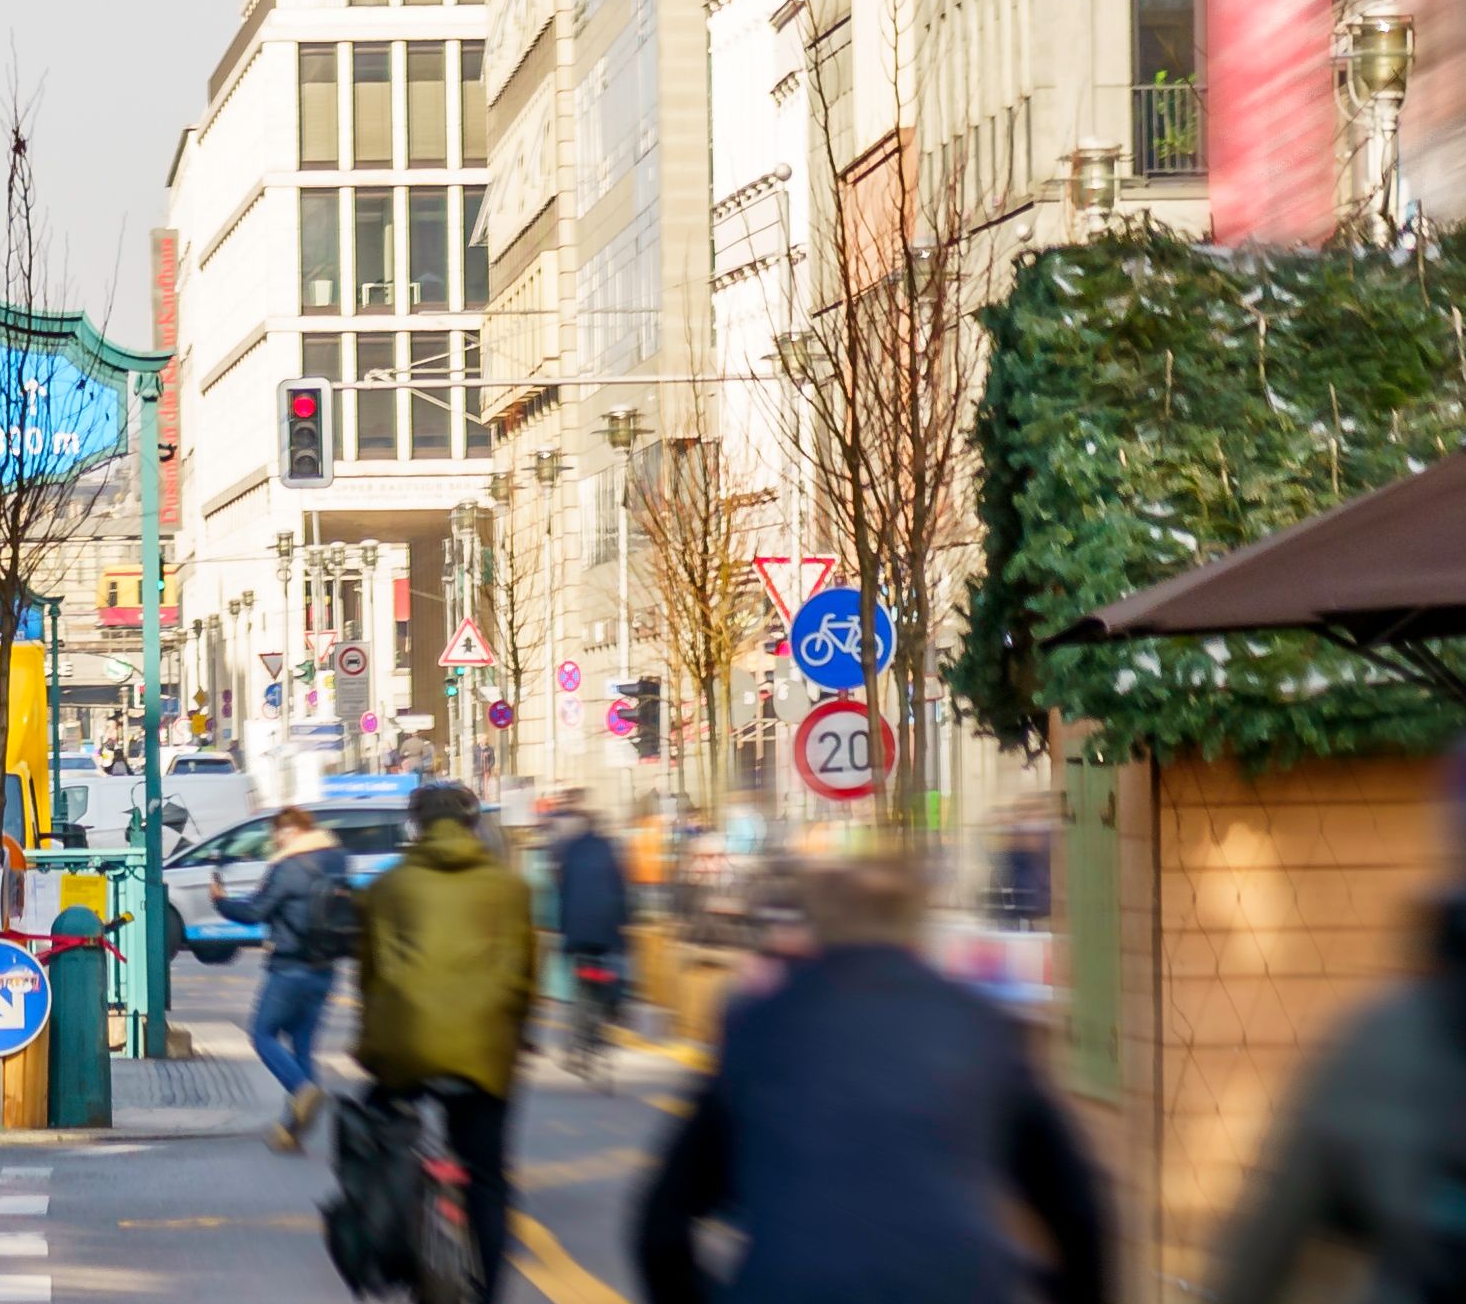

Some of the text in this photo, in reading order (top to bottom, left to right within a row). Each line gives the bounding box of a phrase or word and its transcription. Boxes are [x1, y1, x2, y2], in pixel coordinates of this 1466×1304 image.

[52, 433, 80, 455] m
[158, 426, 179, 524] Dussmn
[818, 730, 872, 774] 20
